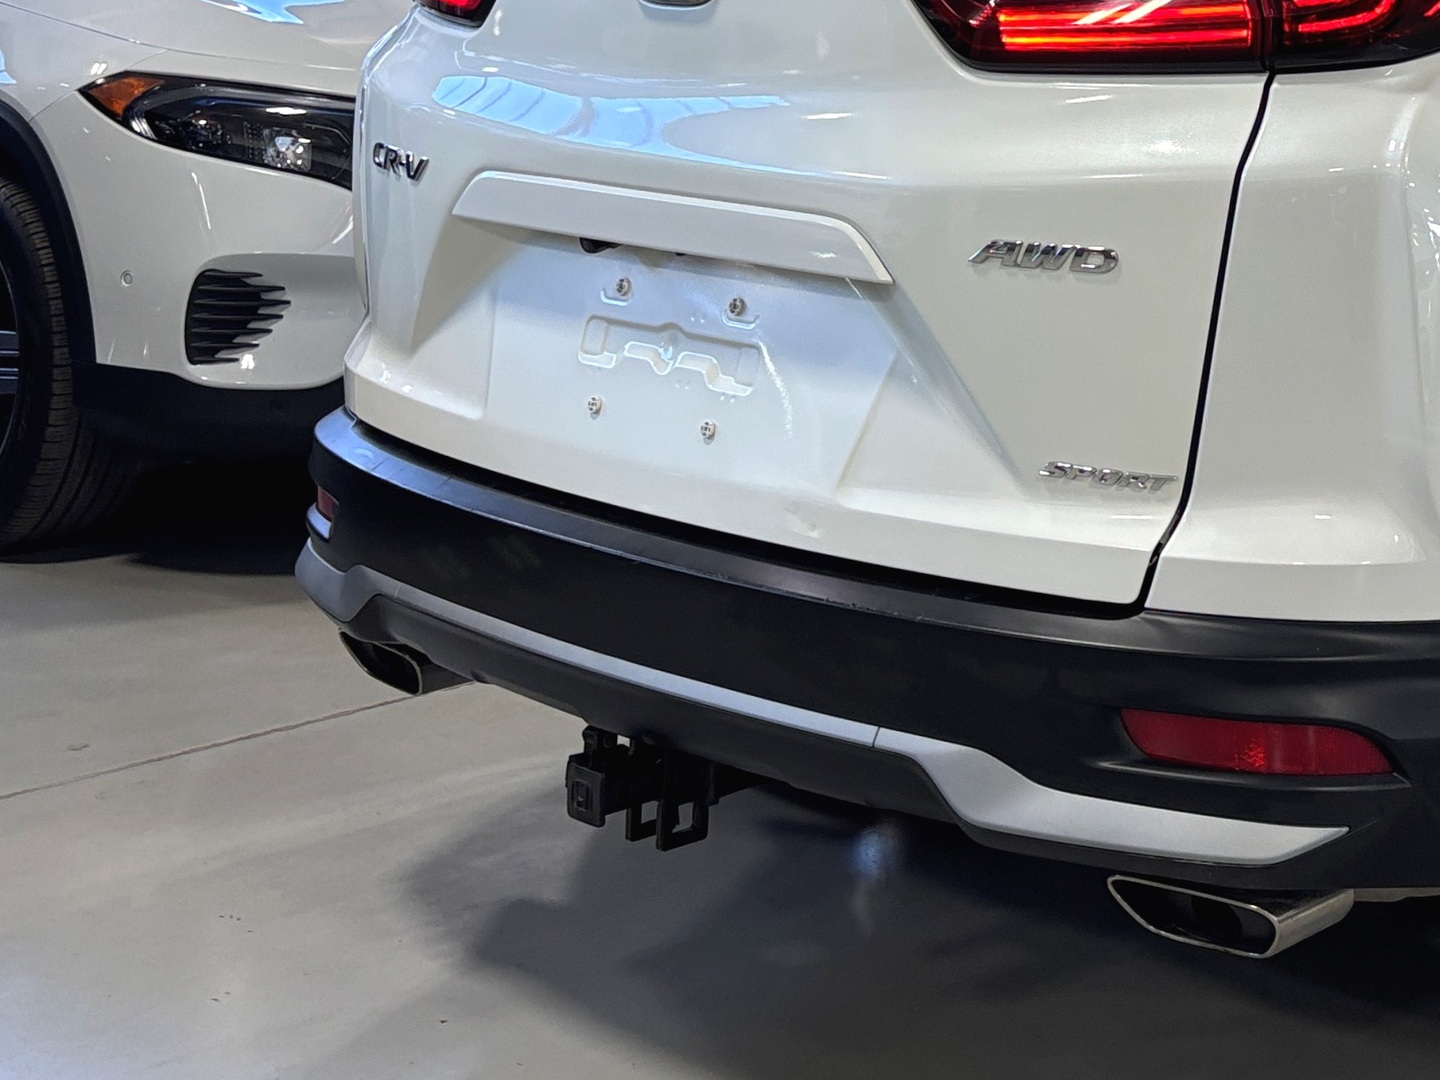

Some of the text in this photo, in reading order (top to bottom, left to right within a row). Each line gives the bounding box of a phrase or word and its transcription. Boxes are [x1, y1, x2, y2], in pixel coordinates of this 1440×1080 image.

[373, 142, 430, 181] CR-V
[968, 239, 1119, 274] AWD
[1039, 461, 1178, 491] SPORT
